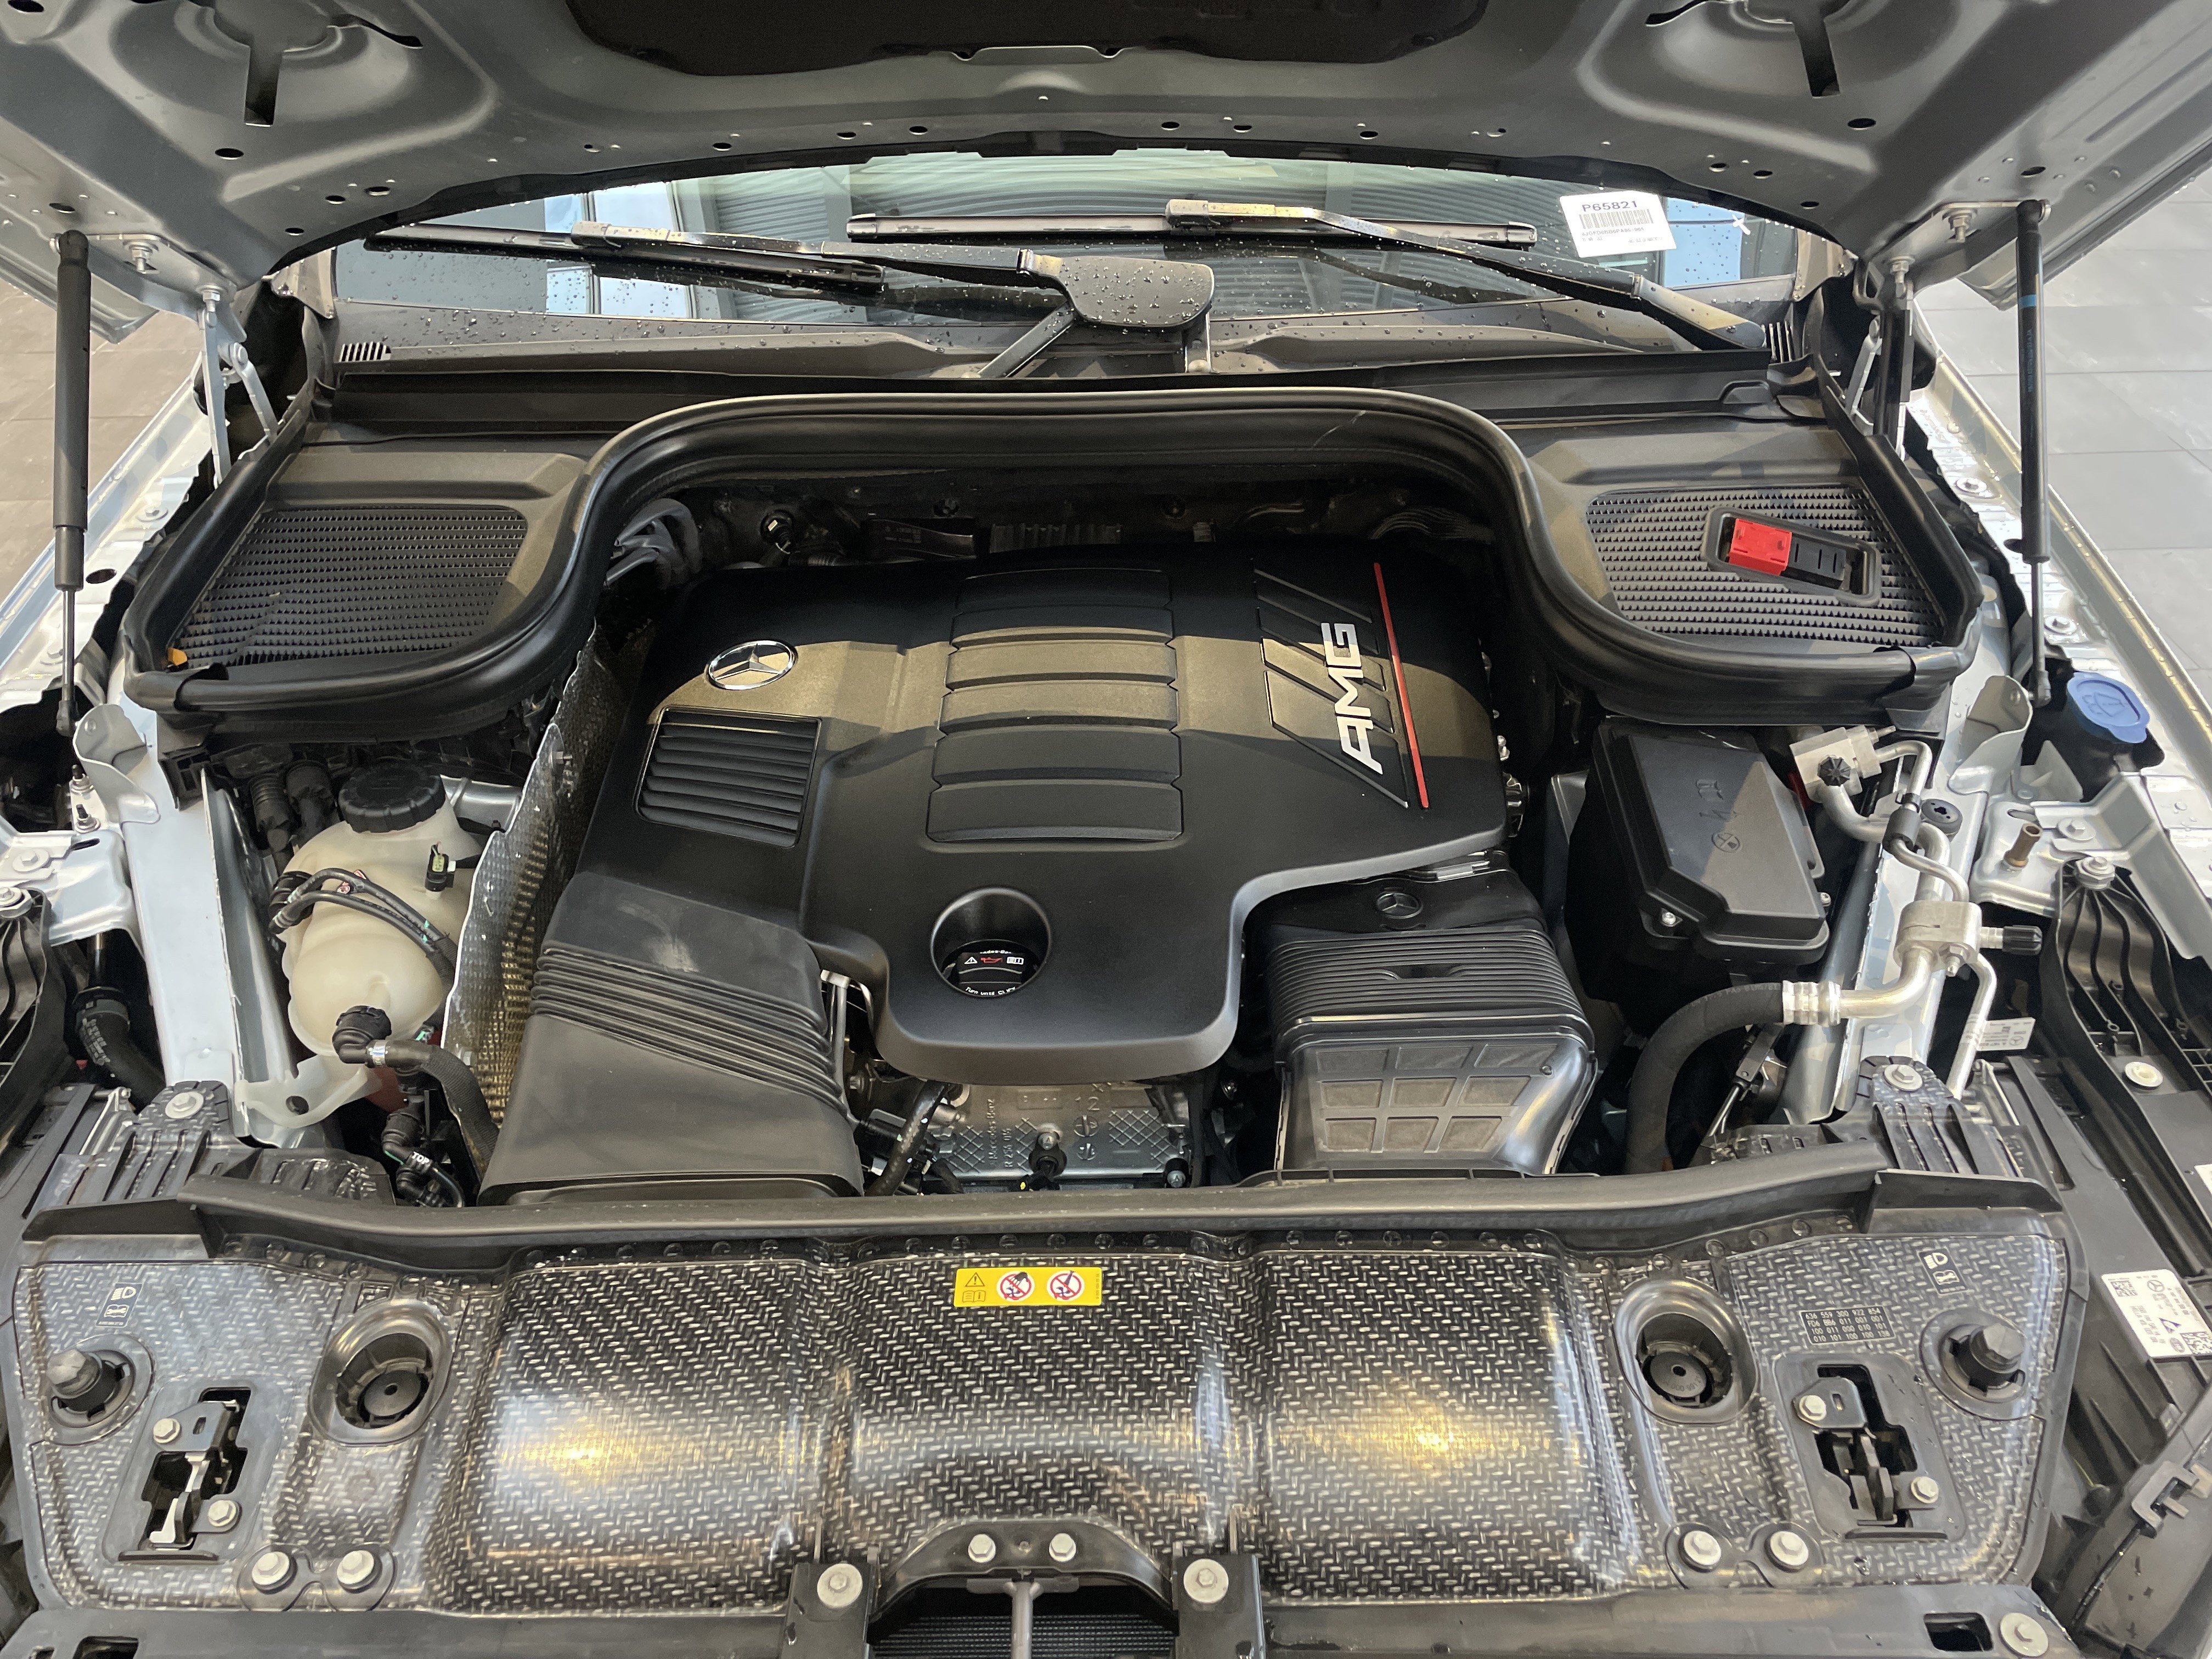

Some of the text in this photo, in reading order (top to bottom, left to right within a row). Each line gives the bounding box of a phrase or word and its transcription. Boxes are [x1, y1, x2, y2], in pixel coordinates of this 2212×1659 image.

[1582, 200, 1638, 212] P65821
[1321, 623, 1383, 775] AMG
[412, 1152, 430, 1164] TOP
